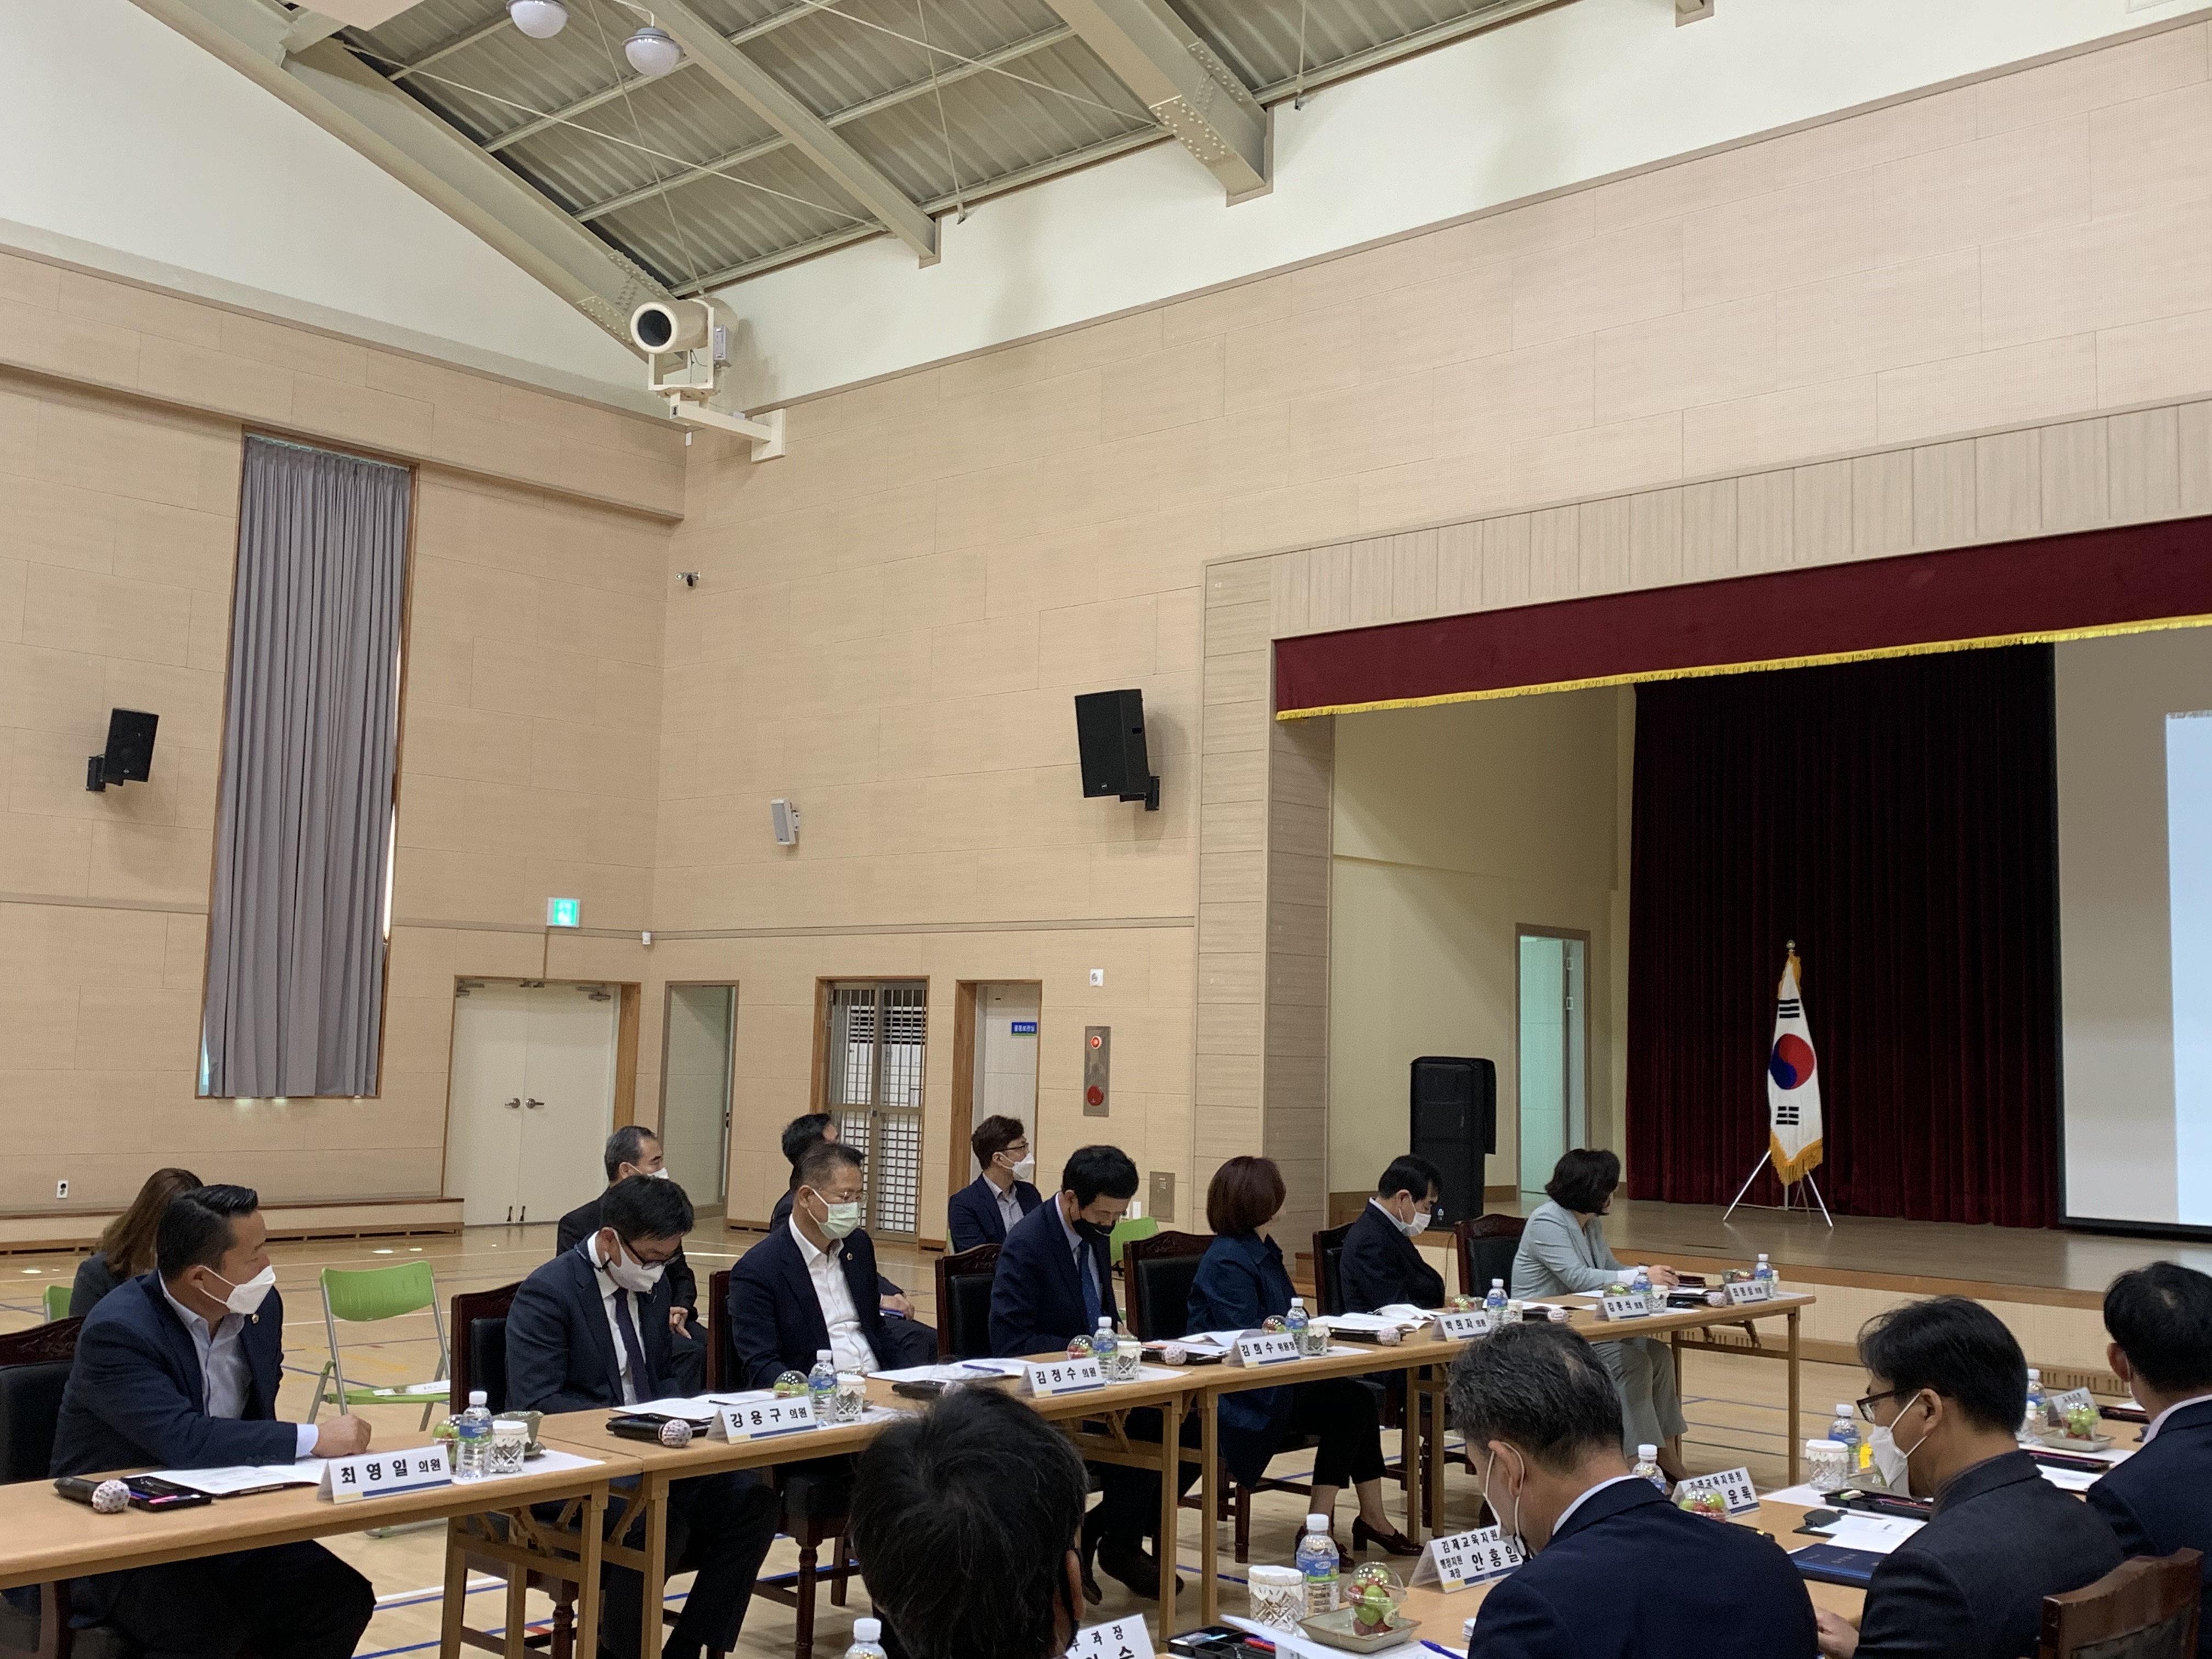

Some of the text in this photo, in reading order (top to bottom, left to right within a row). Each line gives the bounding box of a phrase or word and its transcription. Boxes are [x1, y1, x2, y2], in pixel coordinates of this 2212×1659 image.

[1445, 1318, 1474, 1331] 박희자
[1241, 1341, 1295, 1357] 김희수 위원장
[1036, 1367, 1097, 1384] 김정수 의원
[730, 1407, 808, 1427] 강용구 의원
[341, 1458, 442, 1484] 최영일 의원
[1441, 1529, 1499, 1554] 김제교육지원
